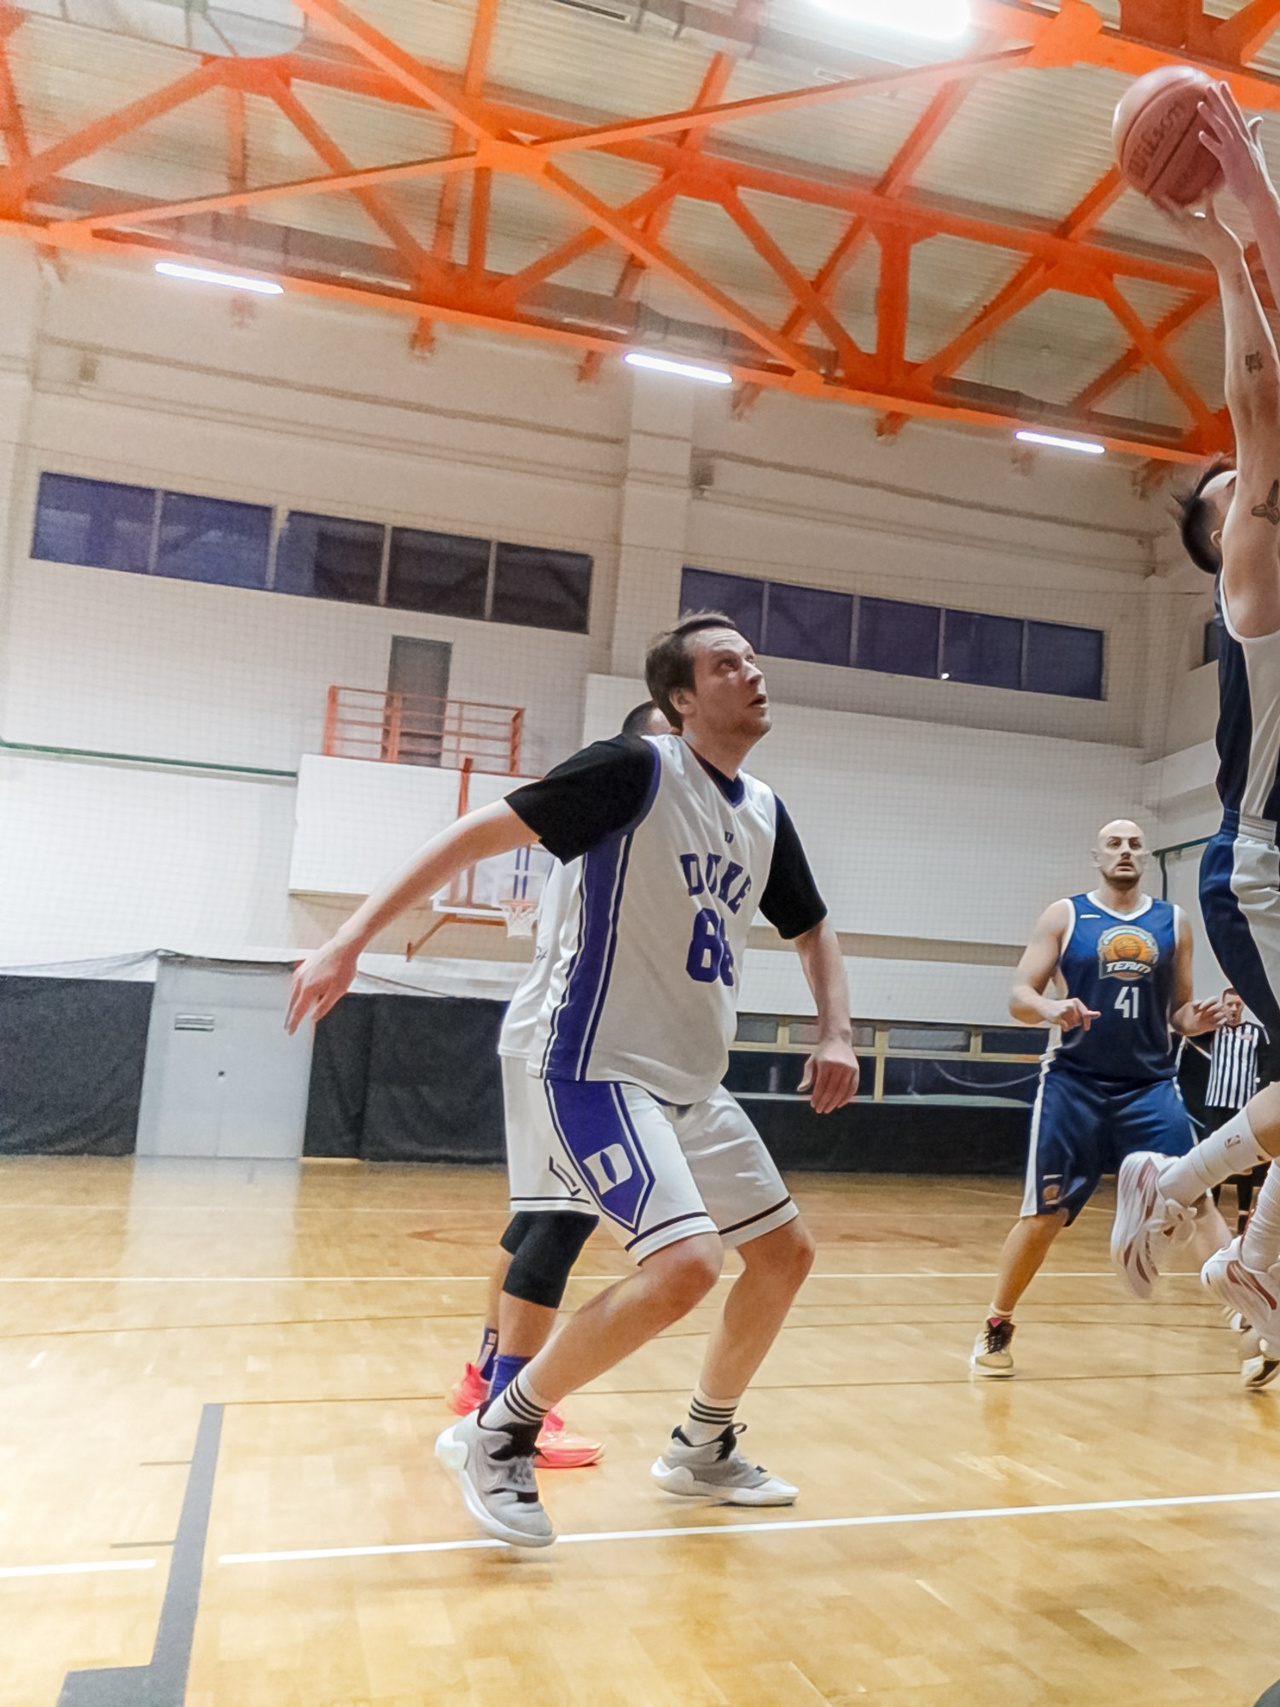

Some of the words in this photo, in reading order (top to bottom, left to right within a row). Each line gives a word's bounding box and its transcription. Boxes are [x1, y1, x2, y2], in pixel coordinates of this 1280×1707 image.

[680, 853, 752, 915] DUKE
[1105, 961, 1152, 974] TEAM
[1114, 986, 1140, 1019] 41
